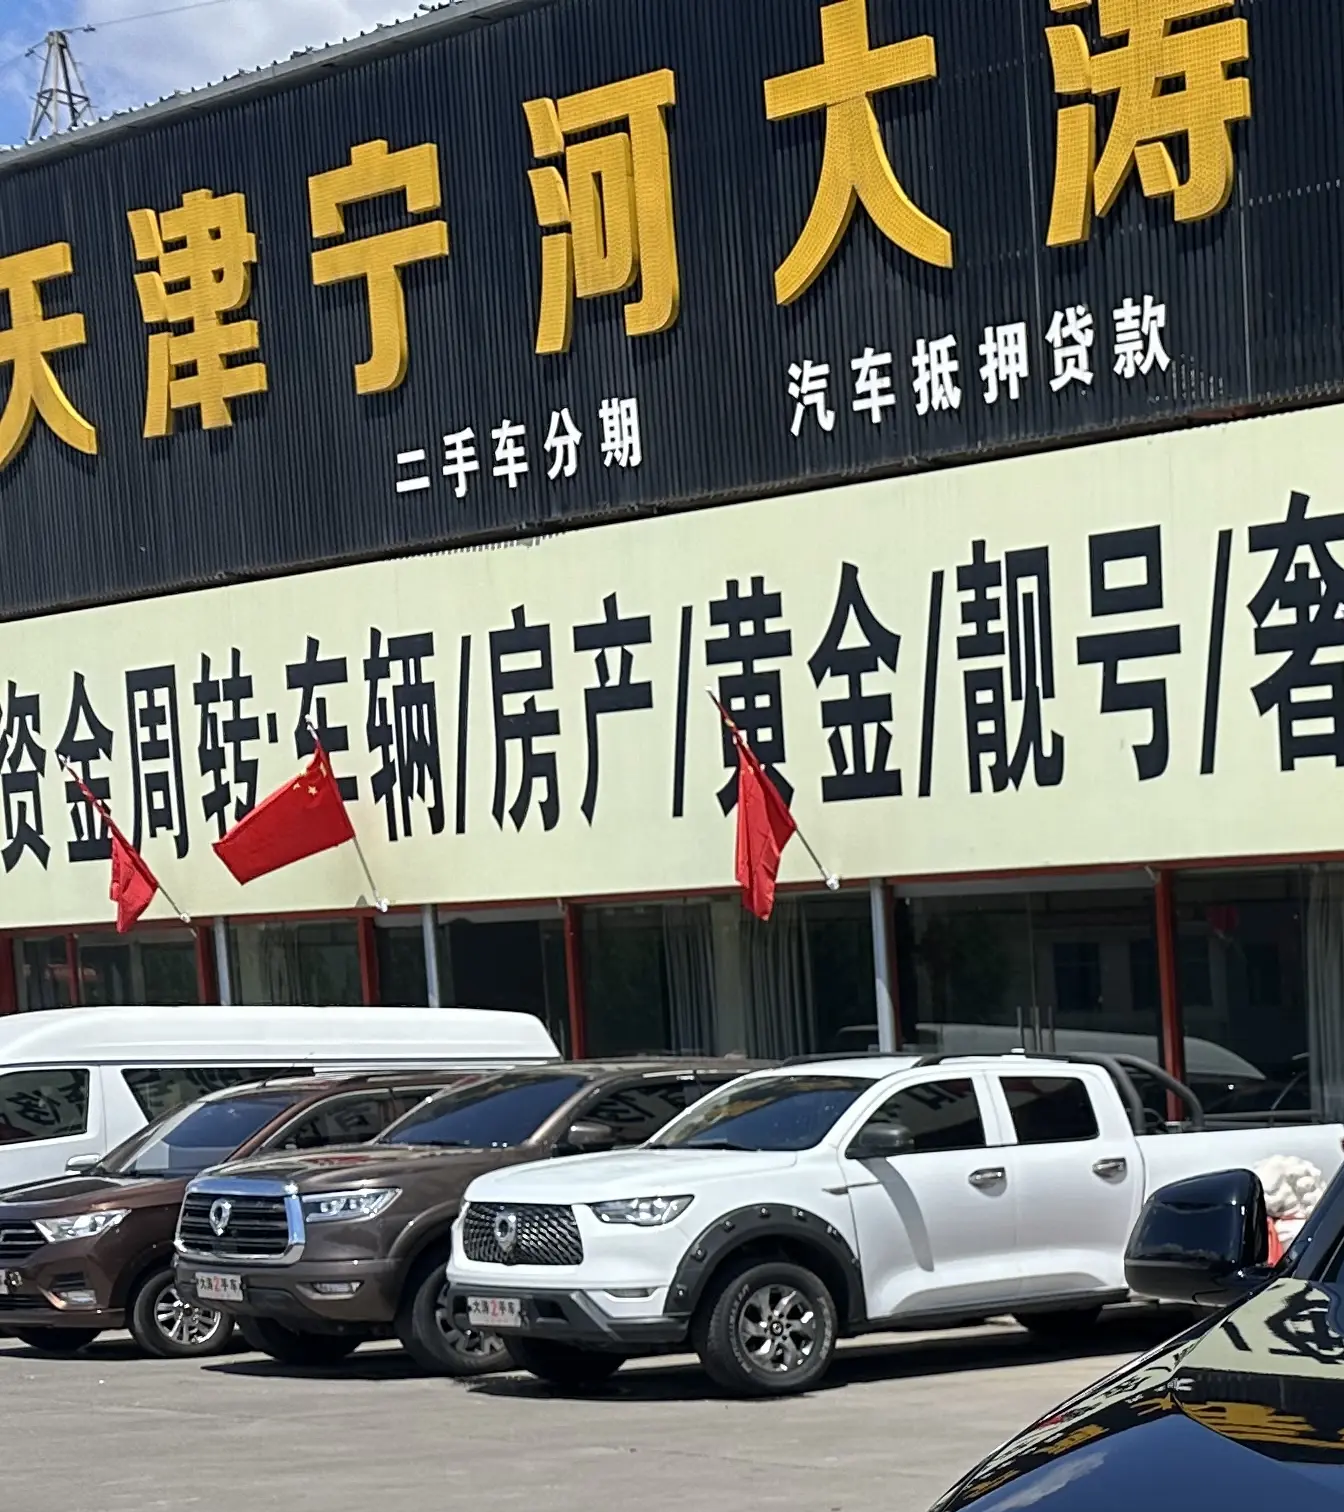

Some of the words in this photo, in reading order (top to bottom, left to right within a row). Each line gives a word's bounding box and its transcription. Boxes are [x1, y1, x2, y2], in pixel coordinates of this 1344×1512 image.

[787, 294, 1171, 437] 汽车抵押贷款
[396, 397, 642, 498] 二手车分期
